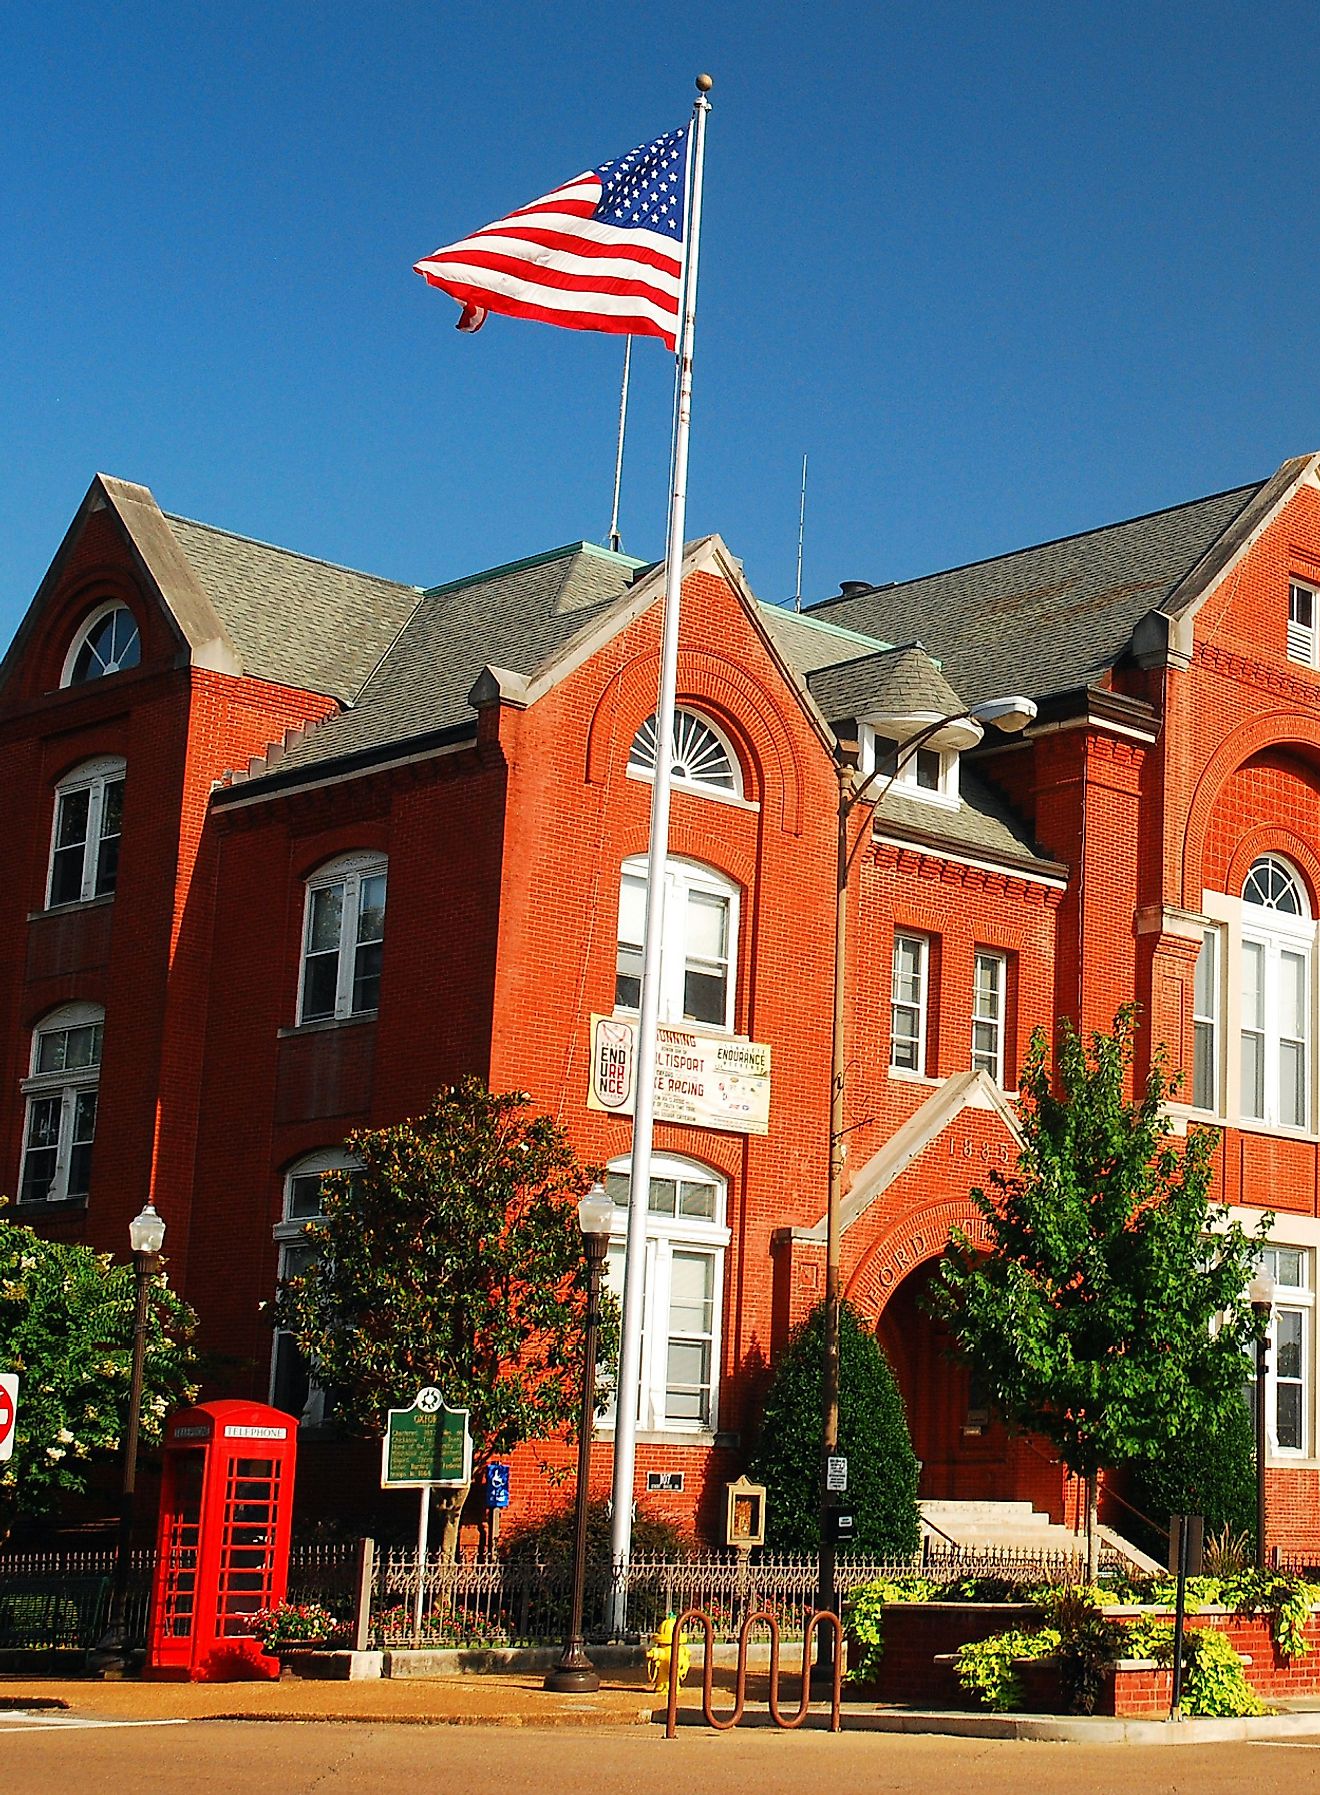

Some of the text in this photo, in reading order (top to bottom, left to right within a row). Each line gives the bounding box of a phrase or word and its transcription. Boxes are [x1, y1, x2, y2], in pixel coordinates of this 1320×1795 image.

[655, 1051, 705, 1073] LTISPORT
[717, 1048, 766, 1067] ENDURANCE
[949, 1136, 1010, 1163] 1885
[413, 1414, 438, 1424] OXFOR
[227, 1426, 283, 1438] TELEPHONE
